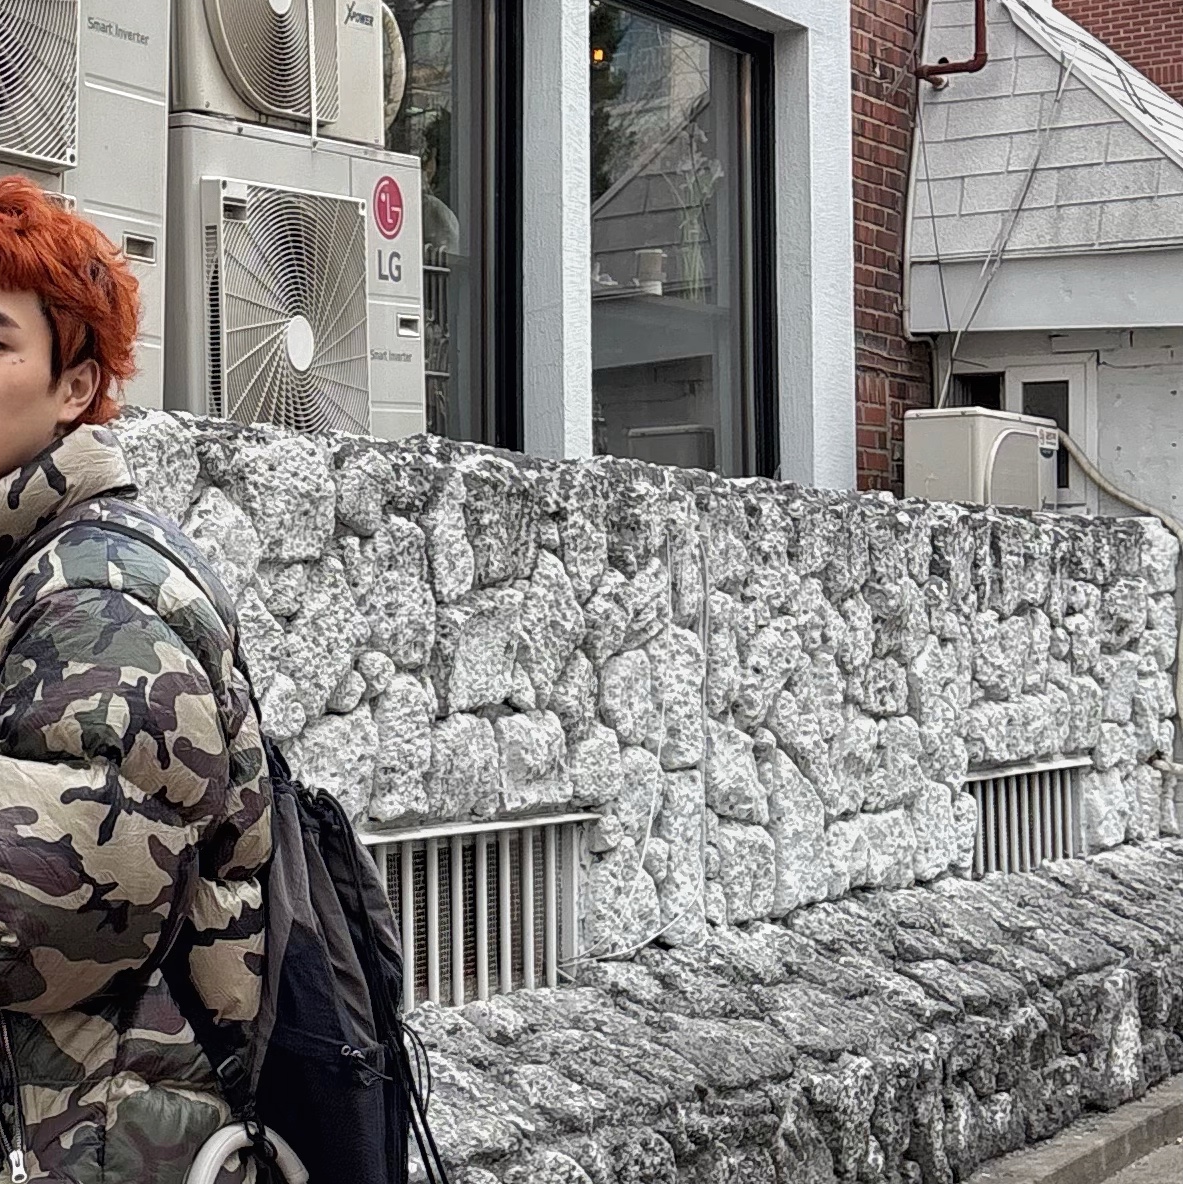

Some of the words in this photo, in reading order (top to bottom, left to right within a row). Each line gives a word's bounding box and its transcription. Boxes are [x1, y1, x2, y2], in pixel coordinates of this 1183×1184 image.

[88, 16, 113, 36] Smart
[115, 23, 150, 45] Inverter
[377, 249, 402, 283] LG
